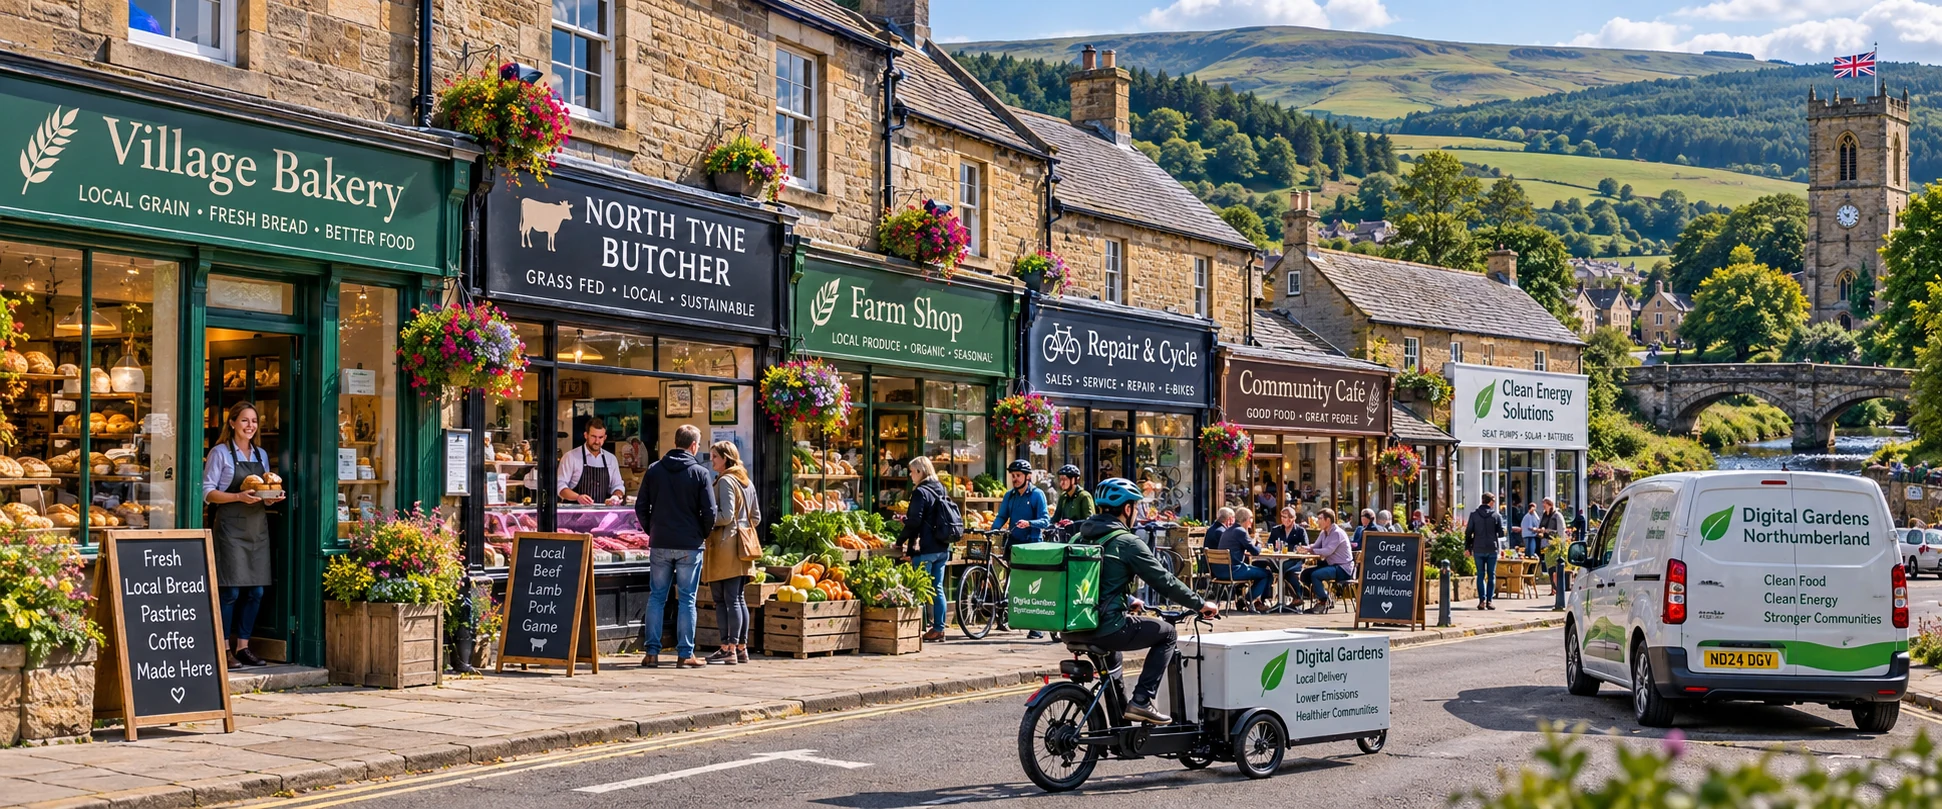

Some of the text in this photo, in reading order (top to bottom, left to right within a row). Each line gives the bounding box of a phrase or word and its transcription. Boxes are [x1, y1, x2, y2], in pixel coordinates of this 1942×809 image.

[102, 116, 404, 223] Village Bakery
[79, 184, 415, 251] LOCAL GRAIN FRESH BREAD BETTER FOOD
[585, 196, 746, 253] NORTH TYNE
[602, 236, 730, 286] BUTCHER
[526, 269, 755, 317] GRASS FED LOCAL SUSTAINABLE
[851, 286, 962, 342] Farm Shop
[832, 332, 860, 346] LOCAL
[862, 336, 900, 351] PRODUCE
[910, 342, 945, 357] ORGANIC
[1087, 330, 1197, 372] Repair & Cycle
[1046, 373, 1195, 396] SALES SERVICE REPAIR E-BIKES
[1240, 370, 1365, 408] Community Café
[1502, 379, 1572, 405] Clean Energy
[1246, 408, 1270, 419] GOOD
[1274, 409, 1296, 420] FOOD
[1305, 412, 1330, 423] GREAT
[1503, 402, 1554, 422] Solutions
[1743, 507, 1869, 527] Digital Gardens
[1744, 528, 1870, 546] Northumberland
[534, 546, 566, 560] Local
[1378, 541, 1405, 552] Great
[144, 549, 182, 567] Fresh
[1374, 555, 1406, 566] Coffee
[534, 564, 562, 578] Beef
[1367, 570, 1412, 581] Local Food
[125, 575, 205, 596] Local Bread
[528, 582, 562, 596] Lamb
[1764, 574, 1826, 587] Clean Food
[1364, 586, 1412, 597] All Welcome
[1764, 592, 1838, 608] Clean Energy
[141, 604, 196, 623] Pastries
[528, 600, 556, 615] Pork
[522, 619, 558, 634] Game
[1764, 611, 1882, 625] Stronger Communities
[148, 632, 195, 650] Coffee
[1296, 646, 1383, 668] Digital Gardens
[1710, 653, 1772, 666] ND24 DGV
[137, 660, 213, 680] Made Here
[1296, 671, 1347, 684] Local Delivery
[1296, 689, 1359, 704] Lower Emissions
[1296, 709, 1330, 721] Healthier
